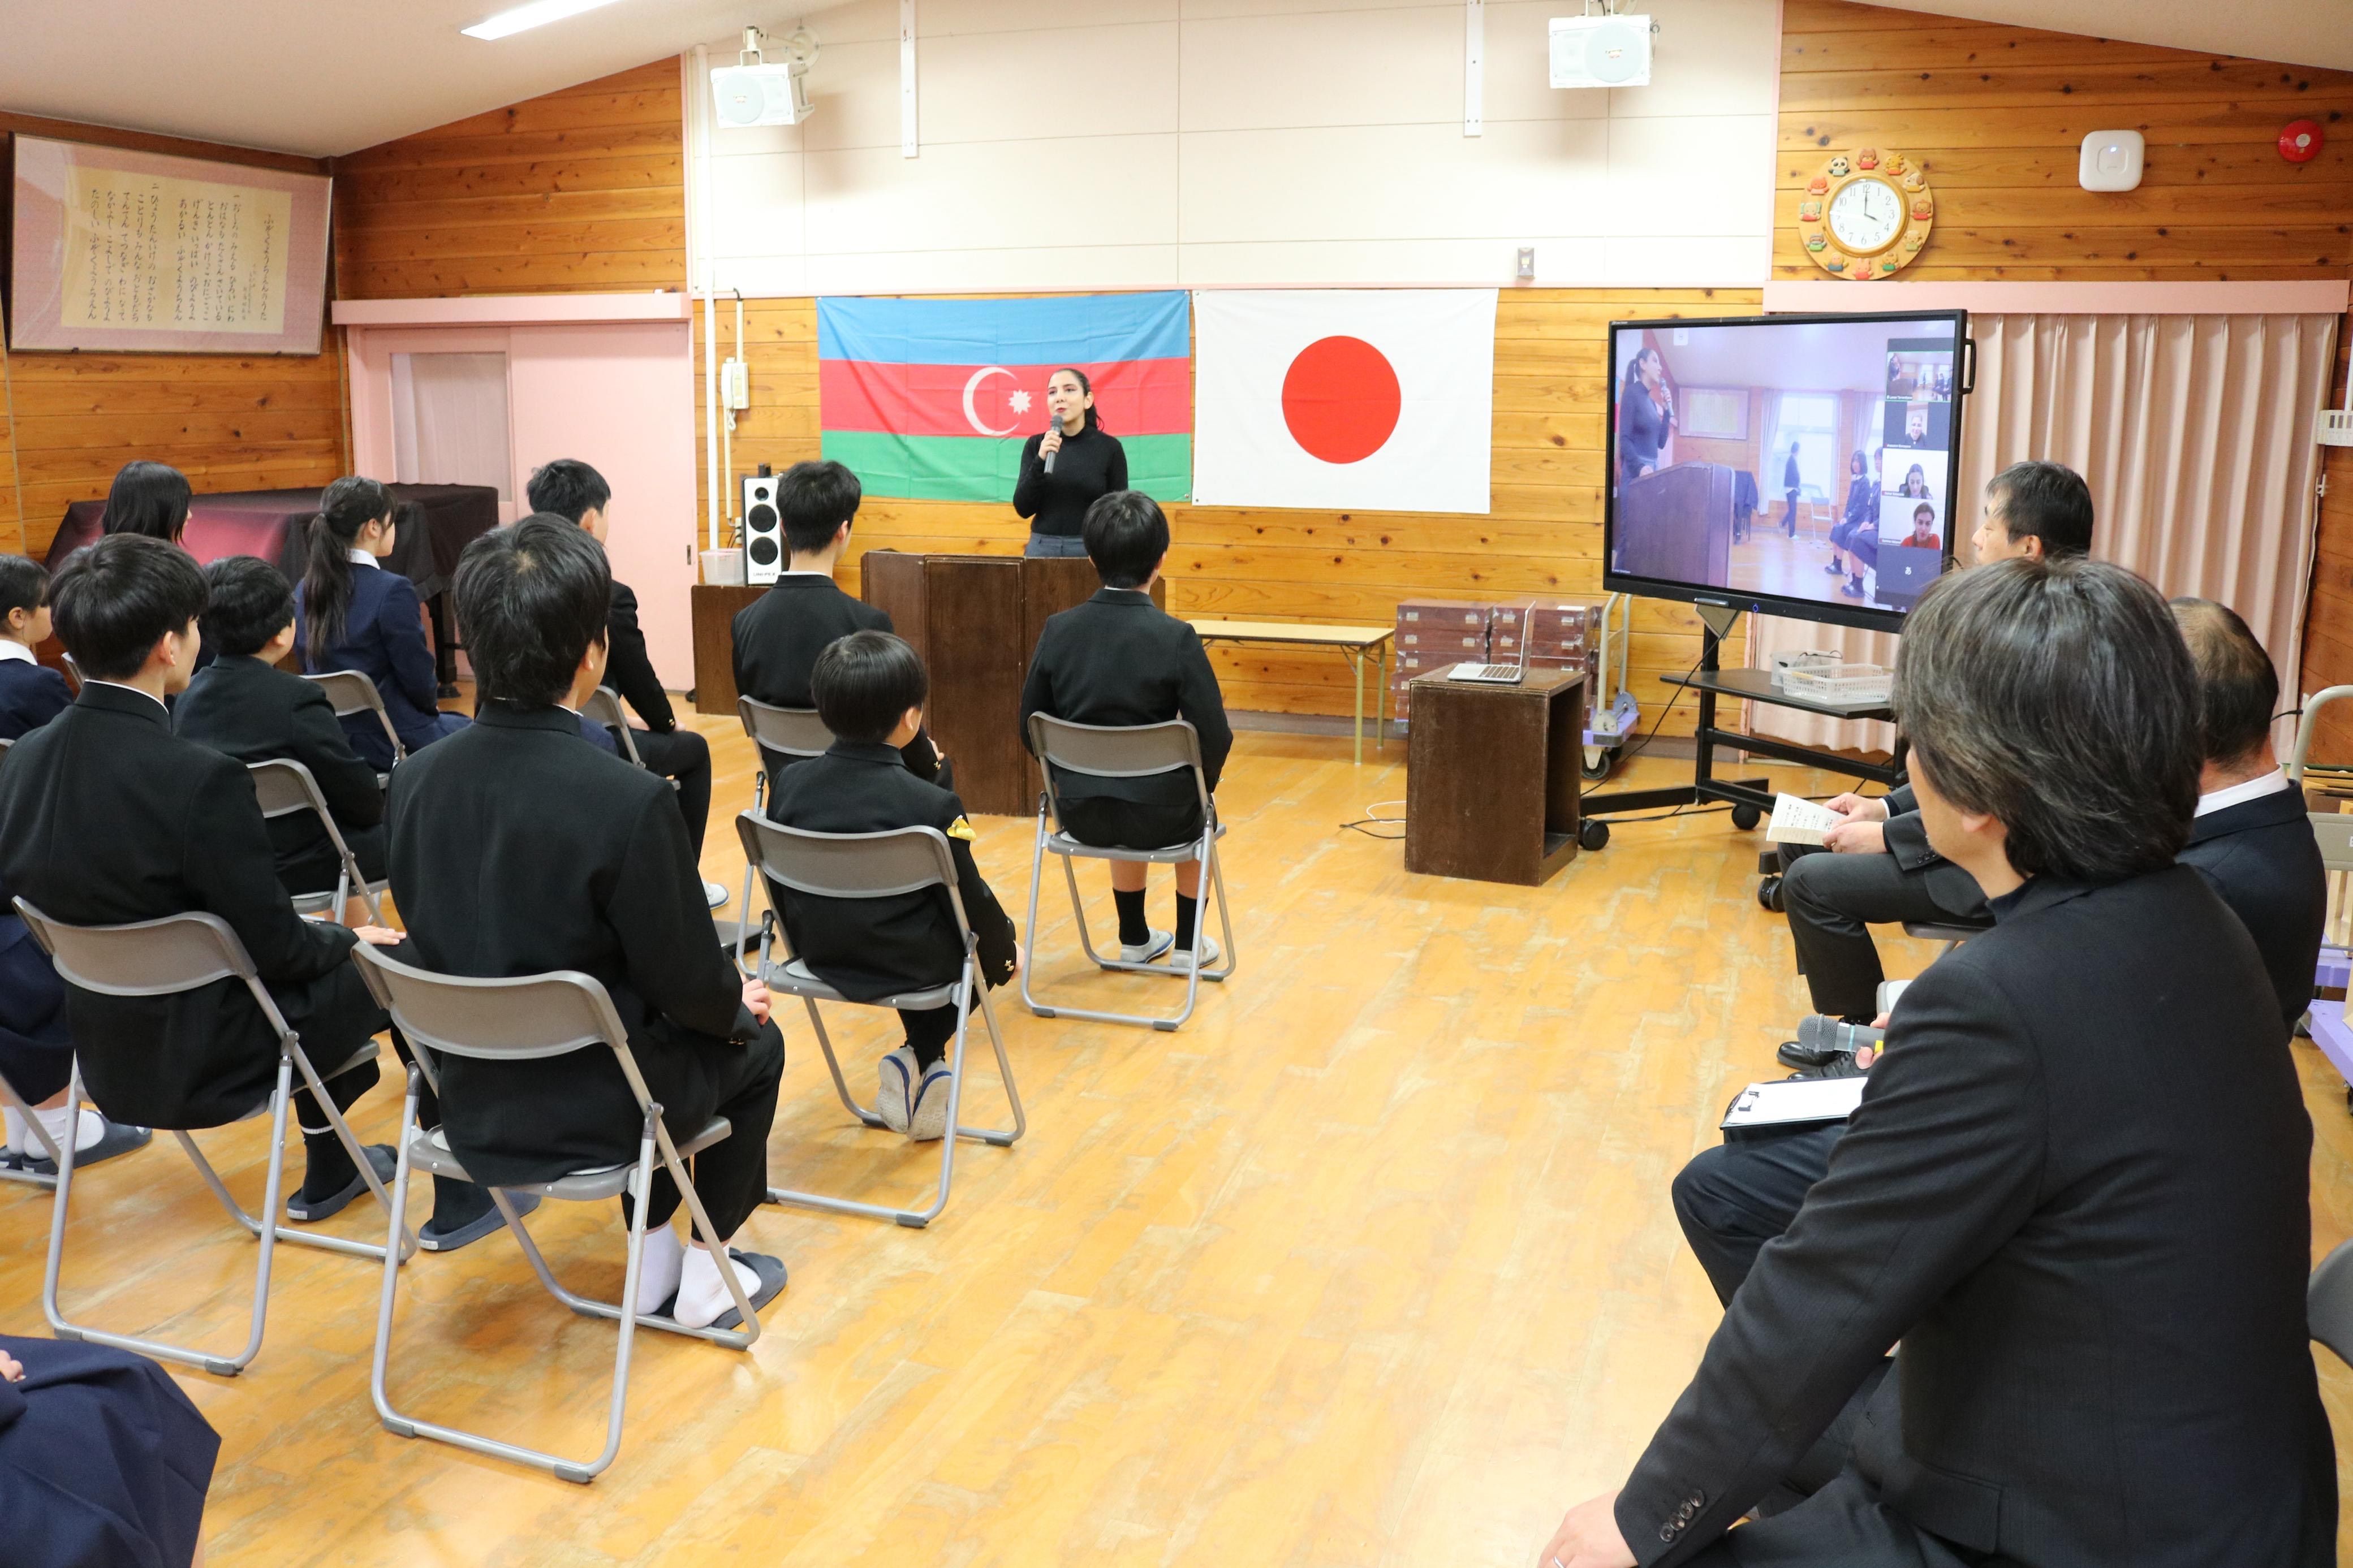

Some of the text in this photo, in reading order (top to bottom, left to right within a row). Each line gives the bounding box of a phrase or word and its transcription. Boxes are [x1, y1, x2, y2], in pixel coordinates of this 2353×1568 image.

[1850, 187, 1855, 196] 11
[1863, 184, 1871, 193] 12
[1839, 197, 1847, 206] 10
[1886, 196, 1891, 205] 2
[1889, 210, 1895, 219] 3
[1839, 223, 1845, 232] 8
[1884, 223, 1889, 232] 4
[1848, 232, 1854, 241] 7
[1861, 235, 1867, 245] 6
[1874, 232, 1880, 241] 5
